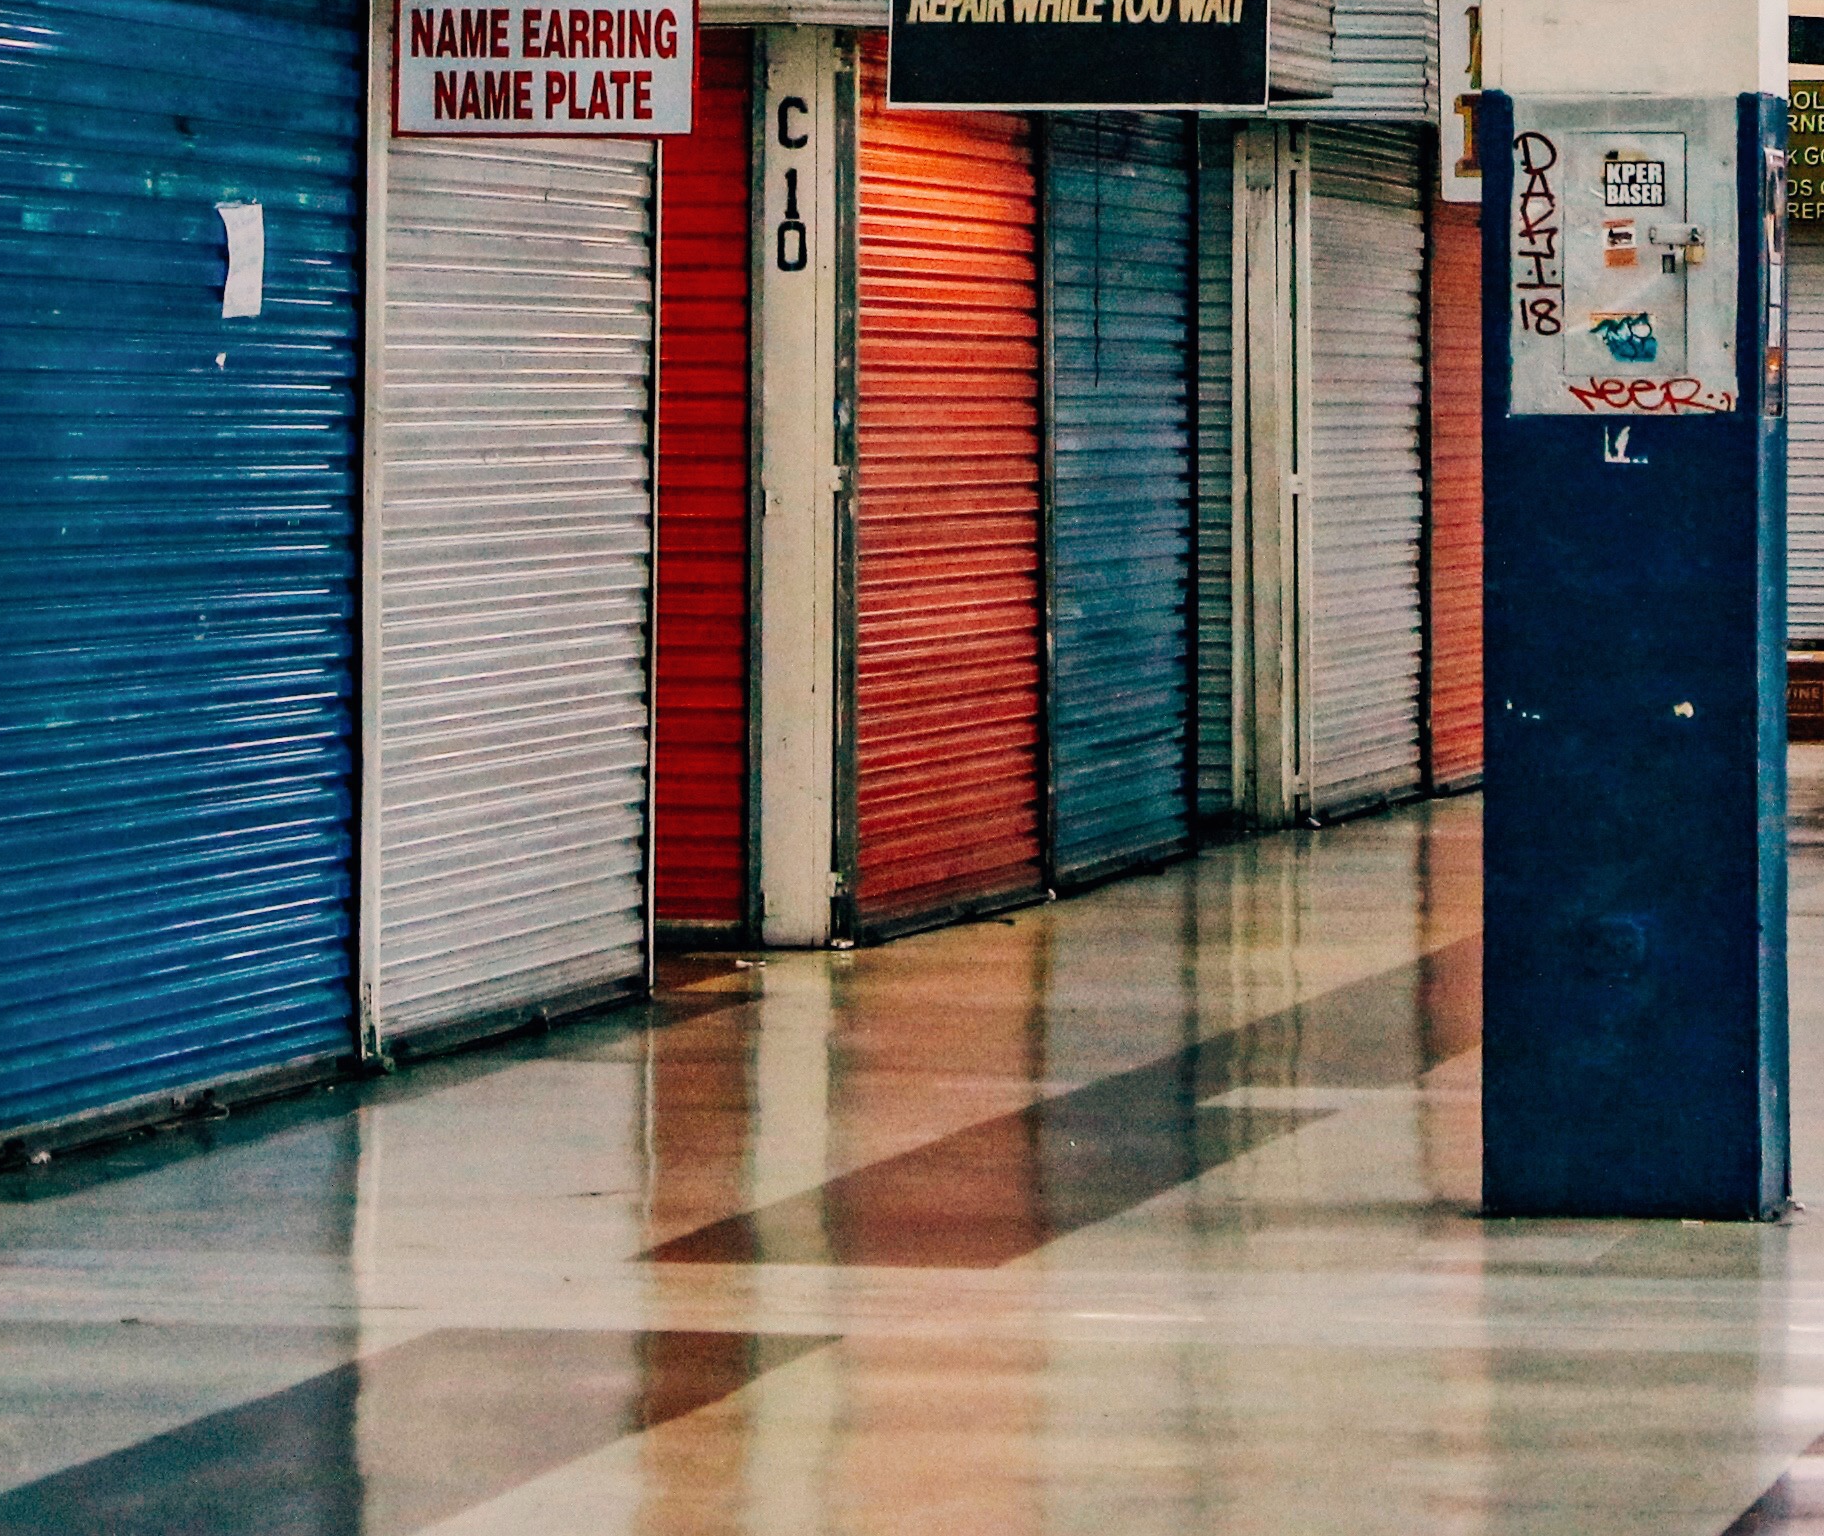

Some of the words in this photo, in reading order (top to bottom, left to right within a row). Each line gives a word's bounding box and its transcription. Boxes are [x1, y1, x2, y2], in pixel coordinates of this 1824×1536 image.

[411, 9, 510, 59] NAME
[522, 9, 677, 59] EARRING
[434, 70, 533, 121] NAME
[545, 70, 653, 120] PLATE
[1606, 163, 1663, 184] KPER
[1606, 184, 1664, 204] BASER
